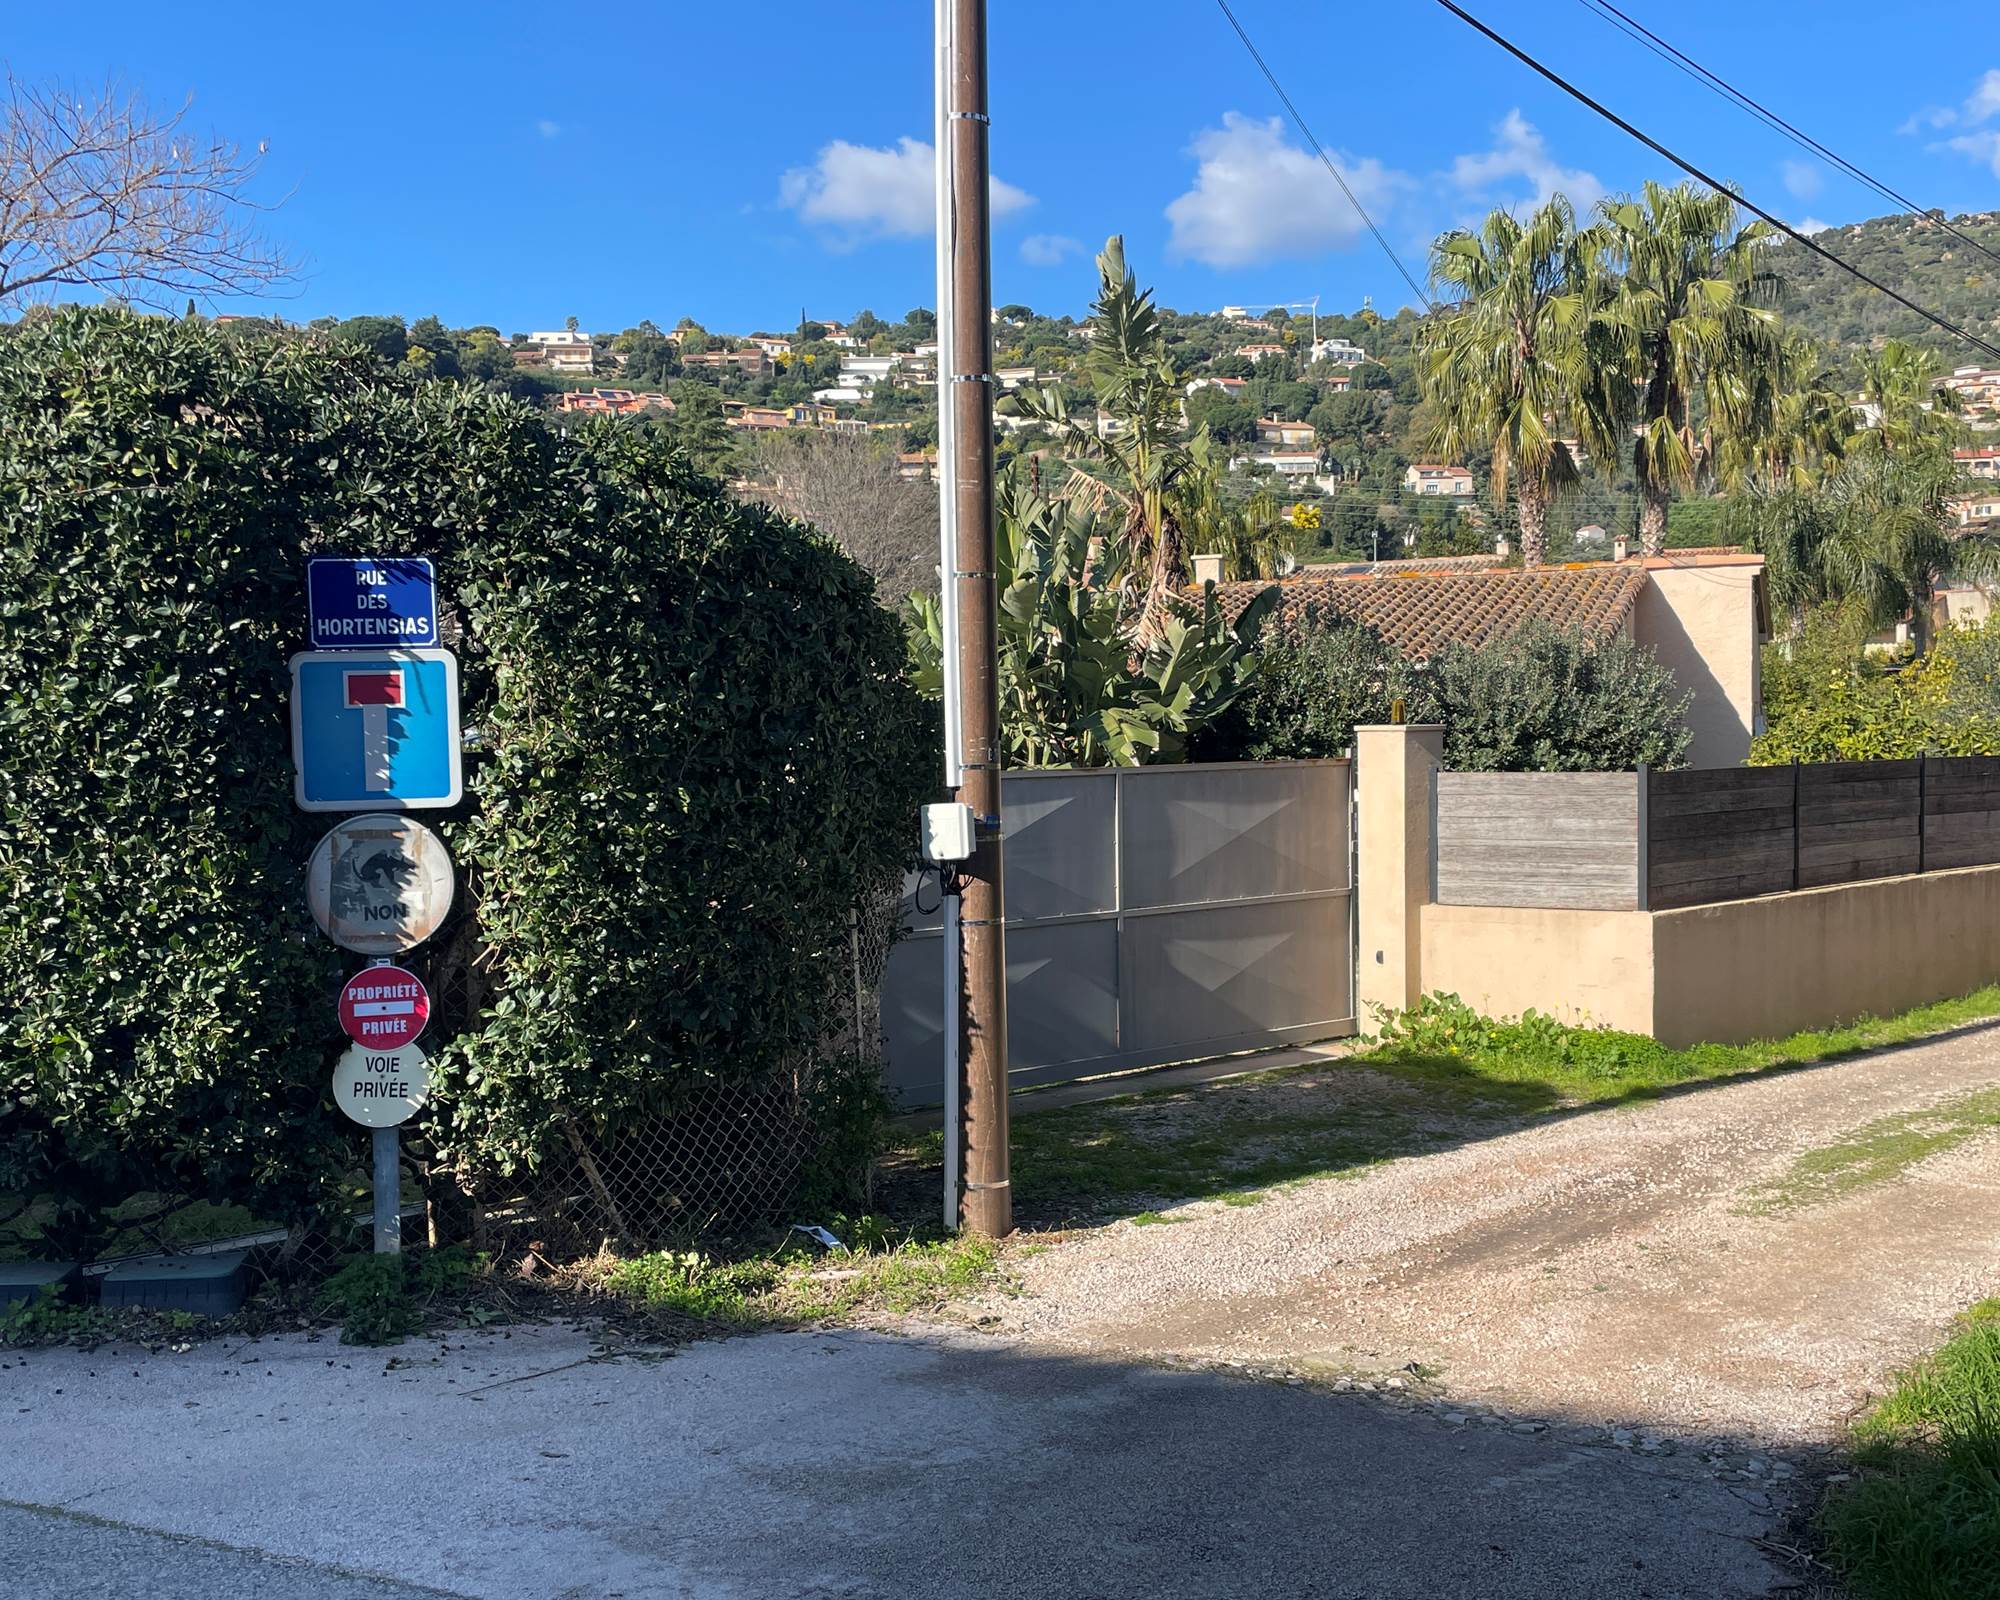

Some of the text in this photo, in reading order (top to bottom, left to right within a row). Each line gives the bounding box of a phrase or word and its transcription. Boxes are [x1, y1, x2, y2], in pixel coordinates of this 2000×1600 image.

[356, 570, 388, 585] RUE
[357, 594, 388, 609] DES
[317, 617, 430, 635] HORTENSIAS
[364, 903, 407, 921] NON
[348, 982, 419, 1001] PROPRIÉTÉ
[362, 1018, 407, 1035] PRIVÉE
[365, 1057, 400, 1073] VOIE
[353, 1078, 409, 1098] PRIVÉE
